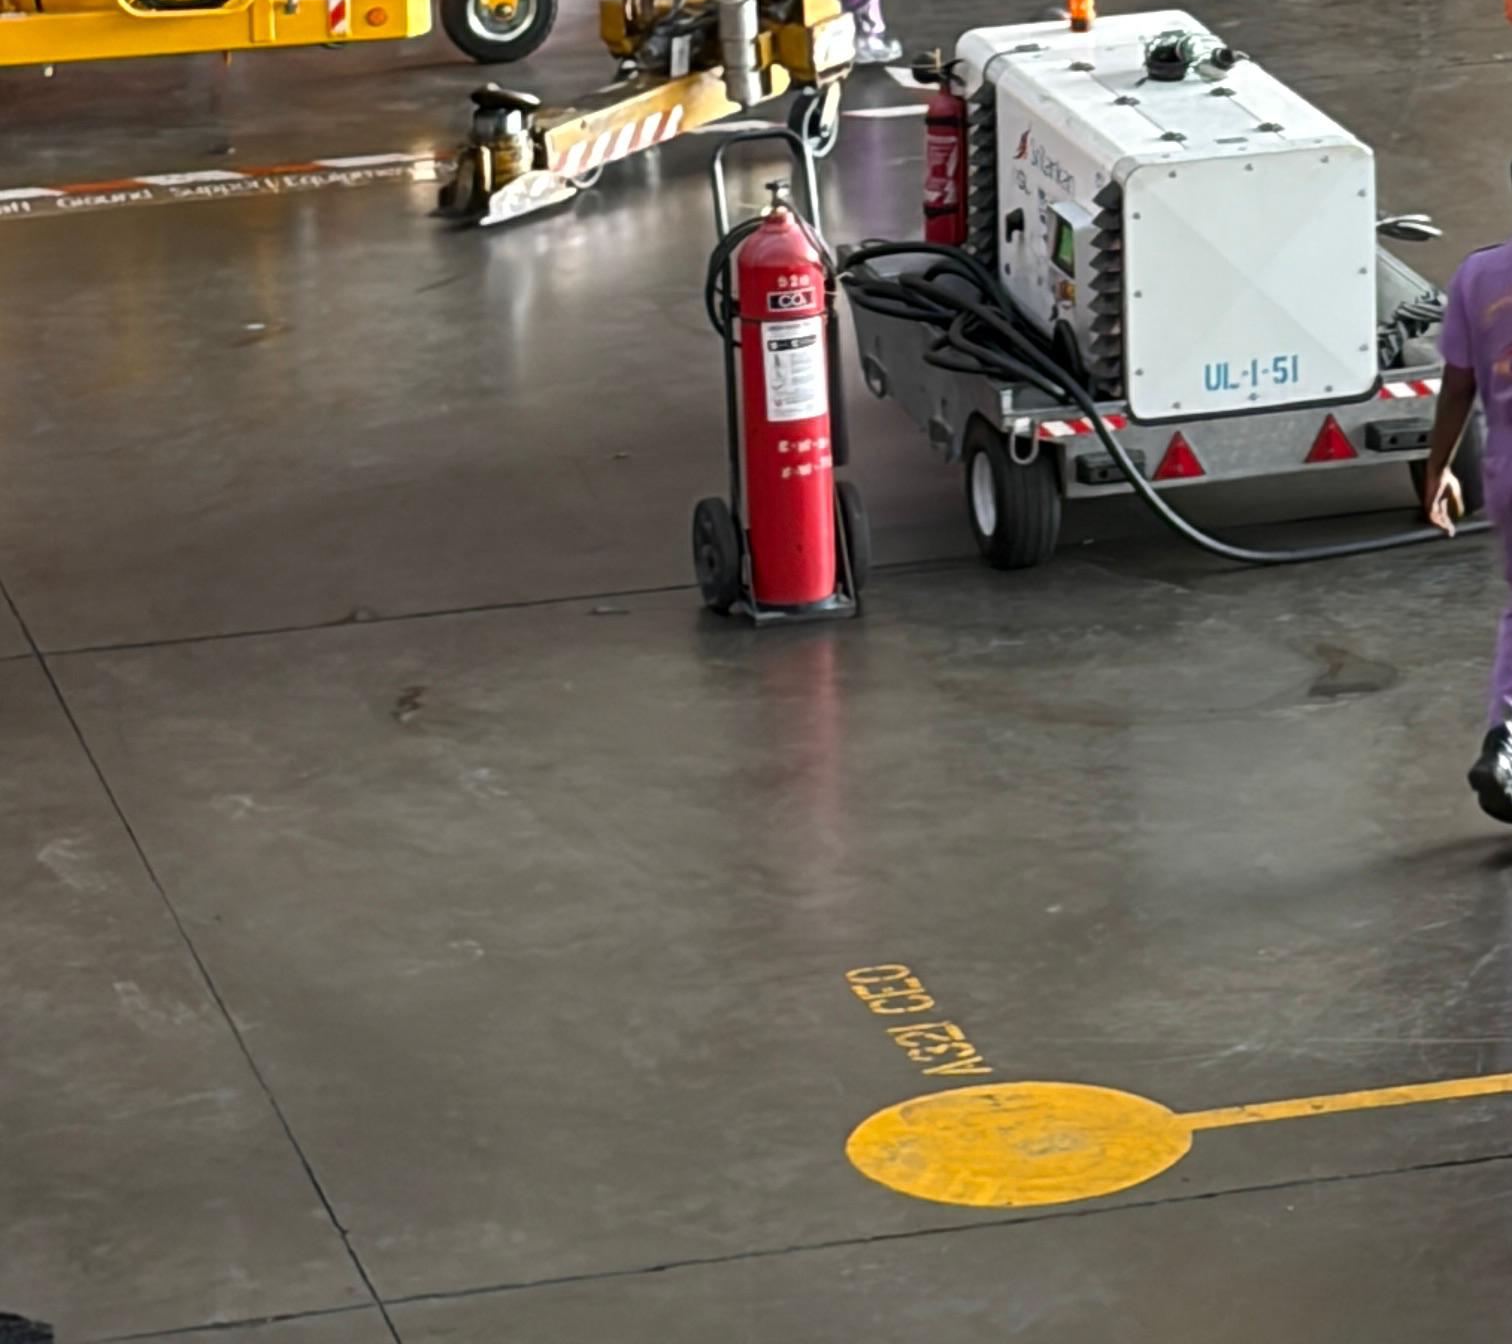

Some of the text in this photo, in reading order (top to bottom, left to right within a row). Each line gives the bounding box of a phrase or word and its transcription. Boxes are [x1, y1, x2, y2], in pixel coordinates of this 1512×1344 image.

[1205, 354, 1298, 391] UL-1-51
[845, 964, 993, 1075] A321 CEO
